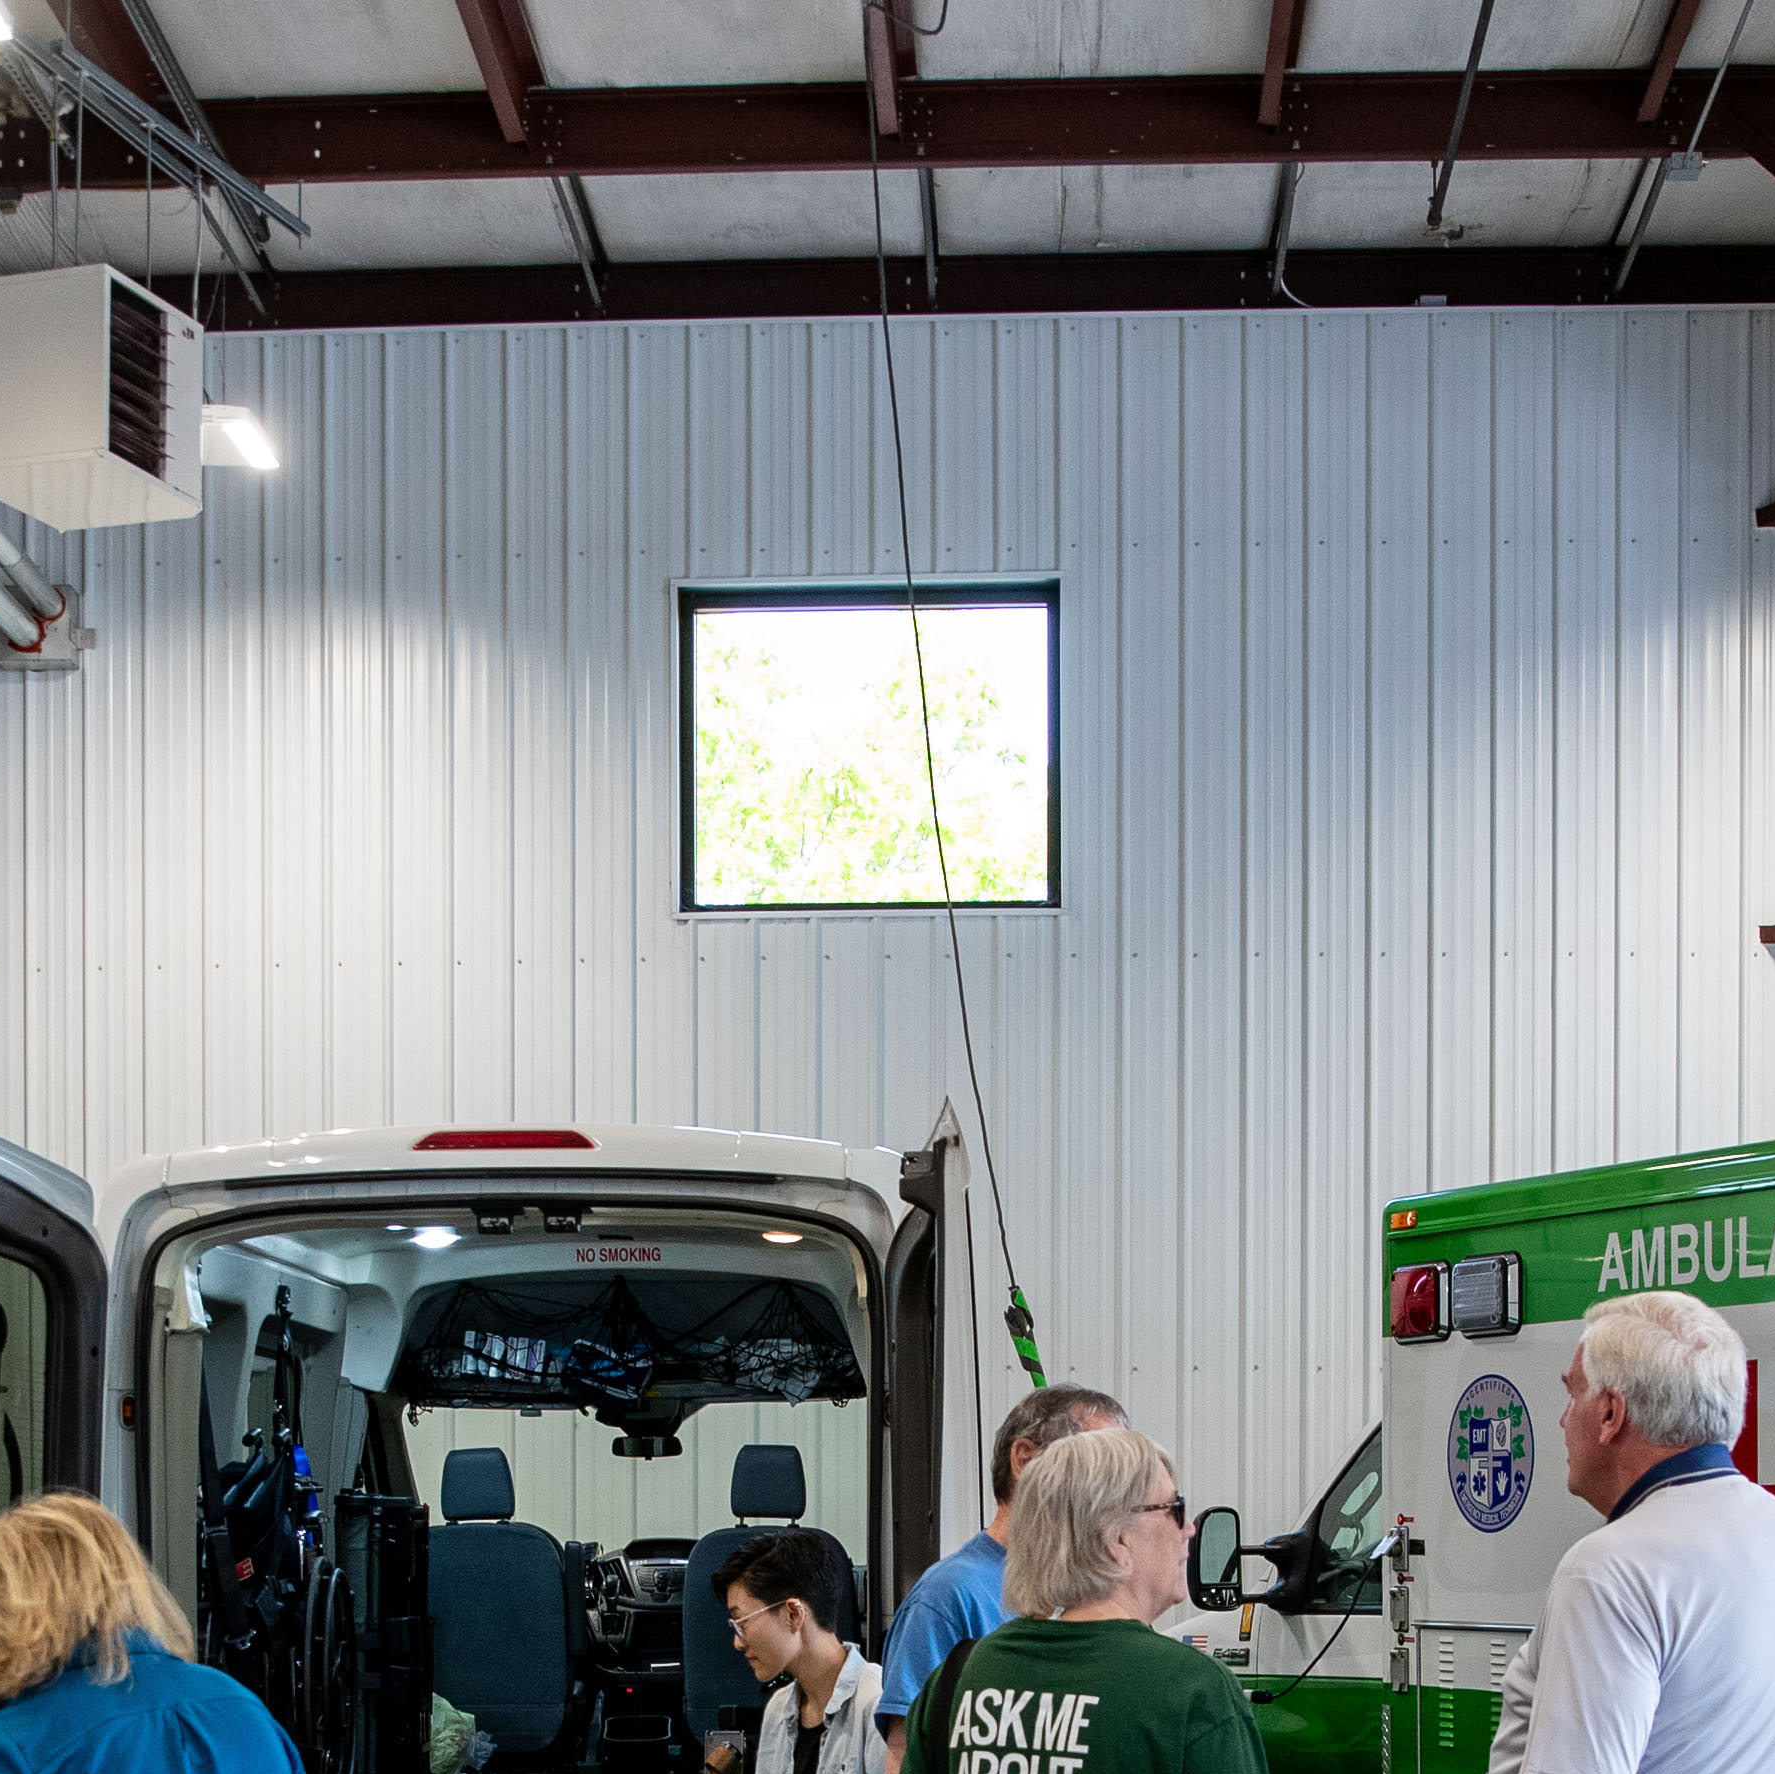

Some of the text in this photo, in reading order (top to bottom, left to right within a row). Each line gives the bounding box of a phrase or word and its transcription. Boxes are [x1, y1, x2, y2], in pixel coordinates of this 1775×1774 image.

[576, 1247, 661, 1262] NO SMOKING
[1469, 1380, 1511, 1399] CERTIFIED
[1472, 1428, 1487, 1444] EMT
[950, 1688, 1100, 1754] ASK ME
